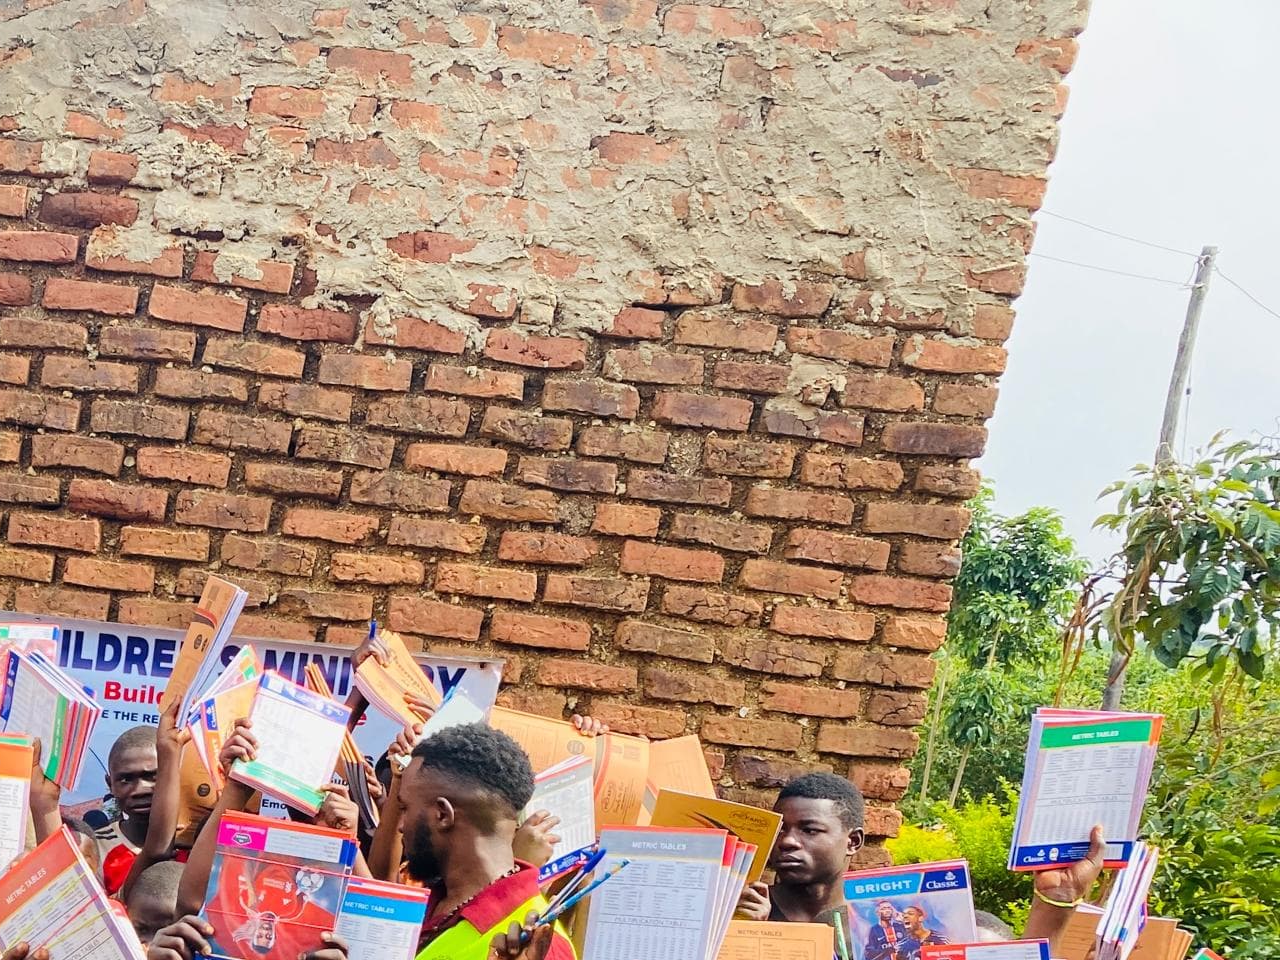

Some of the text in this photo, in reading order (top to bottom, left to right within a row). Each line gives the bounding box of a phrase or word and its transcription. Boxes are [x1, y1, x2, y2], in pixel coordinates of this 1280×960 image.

[113, 710, 138, 722] THE
[631, 841, 688, 851] METRIC TABLES
[5, 867, 48, 904] METRIC TABLES
[855, 879, 913, 894] BRIGHT
[925, 879, 959, 890] Classic
[344, 901, 395, 914] METRIC TABLES
